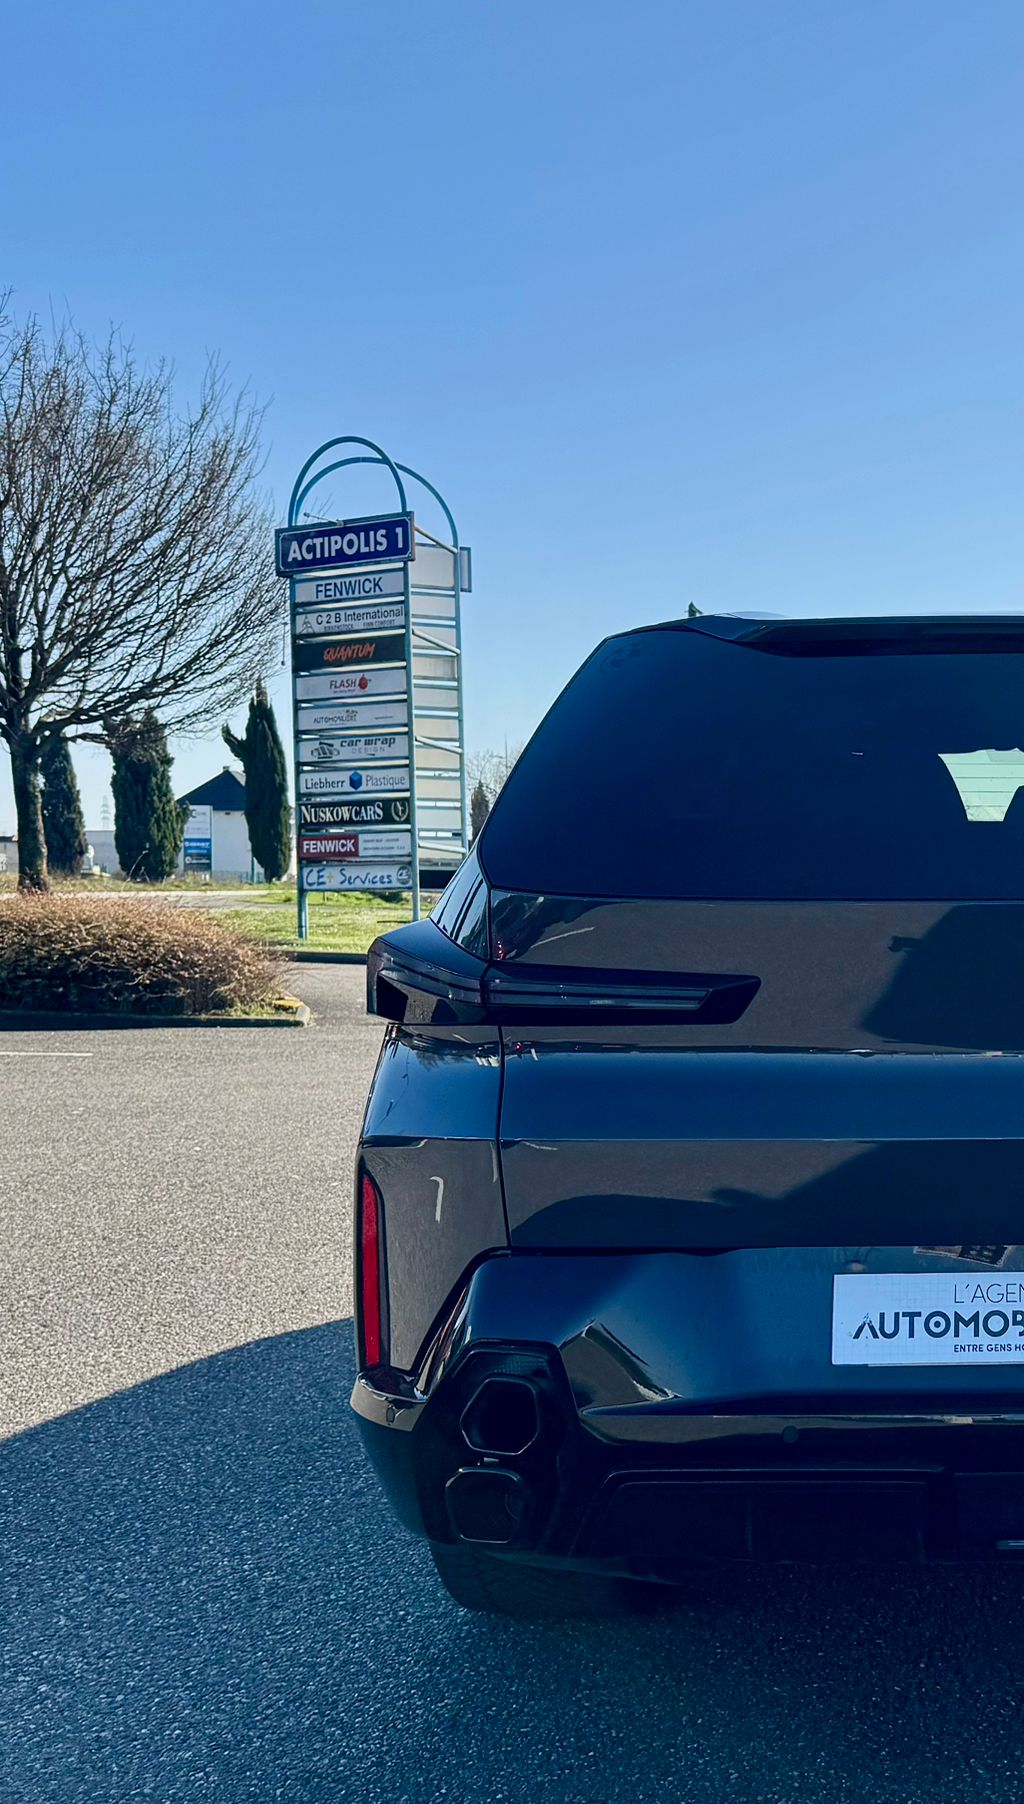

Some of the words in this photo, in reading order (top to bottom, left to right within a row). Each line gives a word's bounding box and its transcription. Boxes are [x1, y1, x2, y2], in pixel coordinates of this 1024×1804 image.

[287, 528, 388, 562] ACTIPOLIS
[395, 526, 403, 549] 1
[315, 577, 383, 599] FENWICK
[316, 614, 323, 625] C
[326, 613, 332, 624] 2
[334, 612, 342, 623] B
[344, 606, 404, 622] International
[323, 643, 376, 661] QUANTUM
[329, 679, 358, 689] FLASH
[340, 739, 361, 748] car
[364, 737, 396, 748] wrap
[304, 777, 346, 790] Liebherr
[365, 774, 406, 790] Plastique
[303, 839, 355, 854] FENWICK
[339, 867, 393, 885] Services
[953, 1344, 984, 1353] ENTRE
[986, 1343, 1013, 1352] GENS
